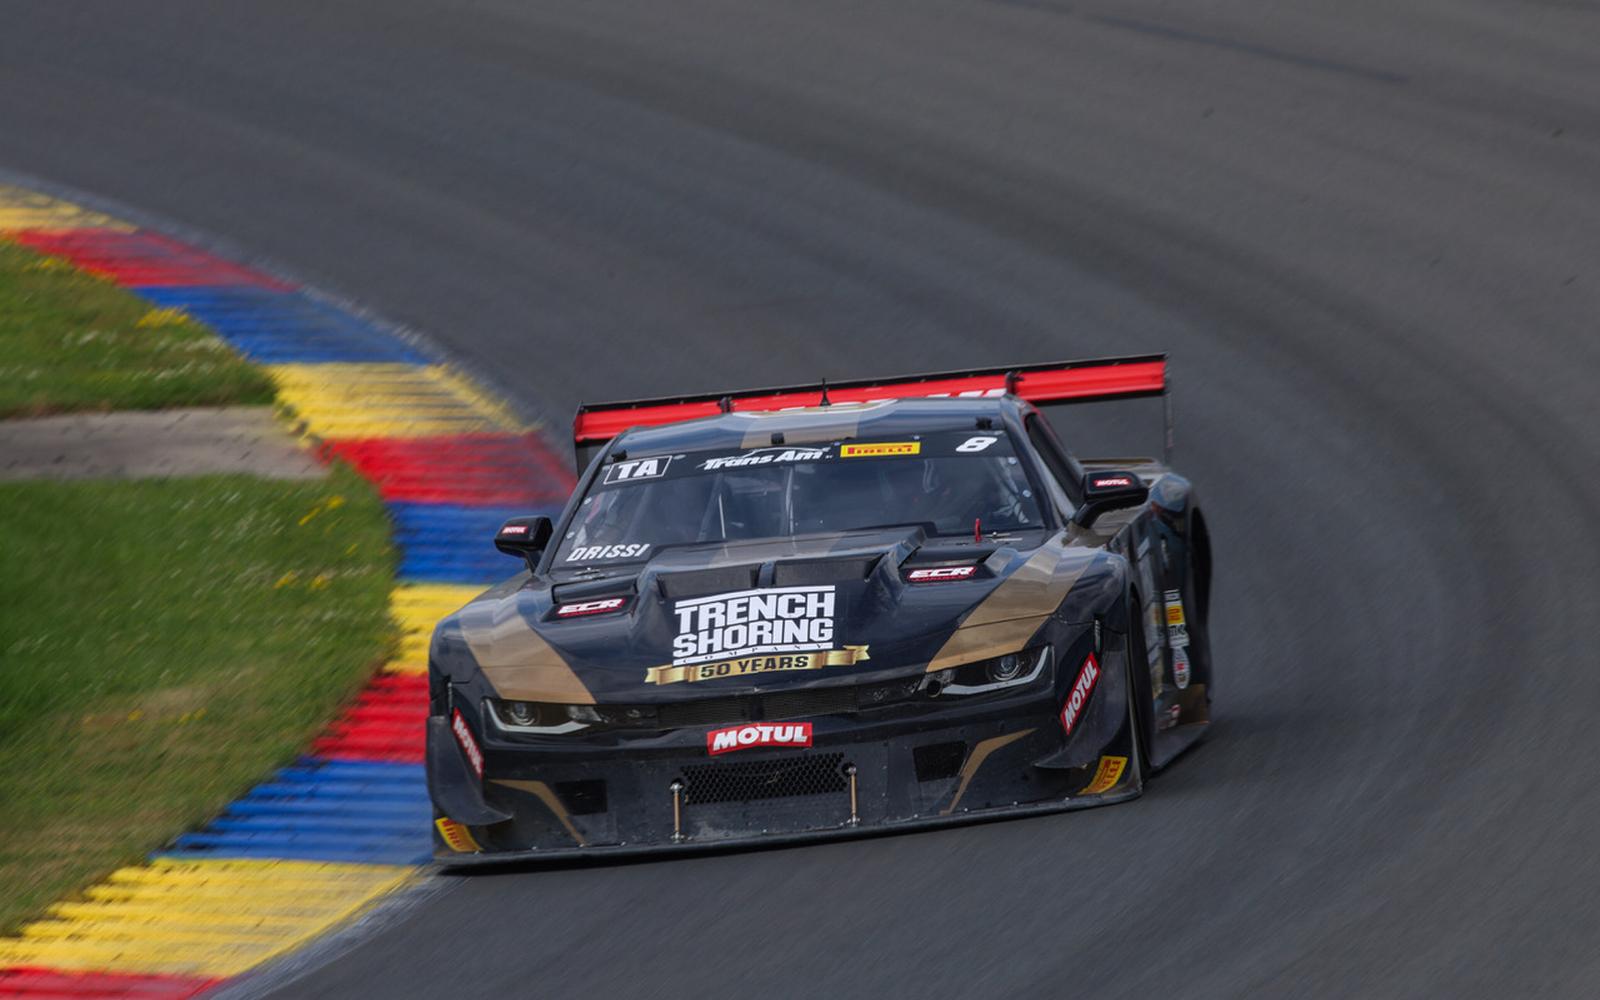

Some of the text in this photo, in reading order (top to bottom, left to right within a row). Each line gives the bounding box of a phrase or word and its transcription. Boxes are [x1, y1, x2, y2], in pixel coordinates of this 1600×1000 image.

[955, 436, 998, 452] 8
[617, 459, 659, 480] TA
[703, 450, 823, 471] Trans Am
[565, 543, 650, 562] DRISSI
[908, 567, 975, 579] ECR
[558, 598, 623, 614] ECR
[674, 592, 836, 634] TRENCH
[672, 618, 834, 658] SHORING
[700, 655, 810, 678] 50 YEARS
[1064, 660, 1098, 730] MOTUL
[712, 726, 808, 751] MOTUL
